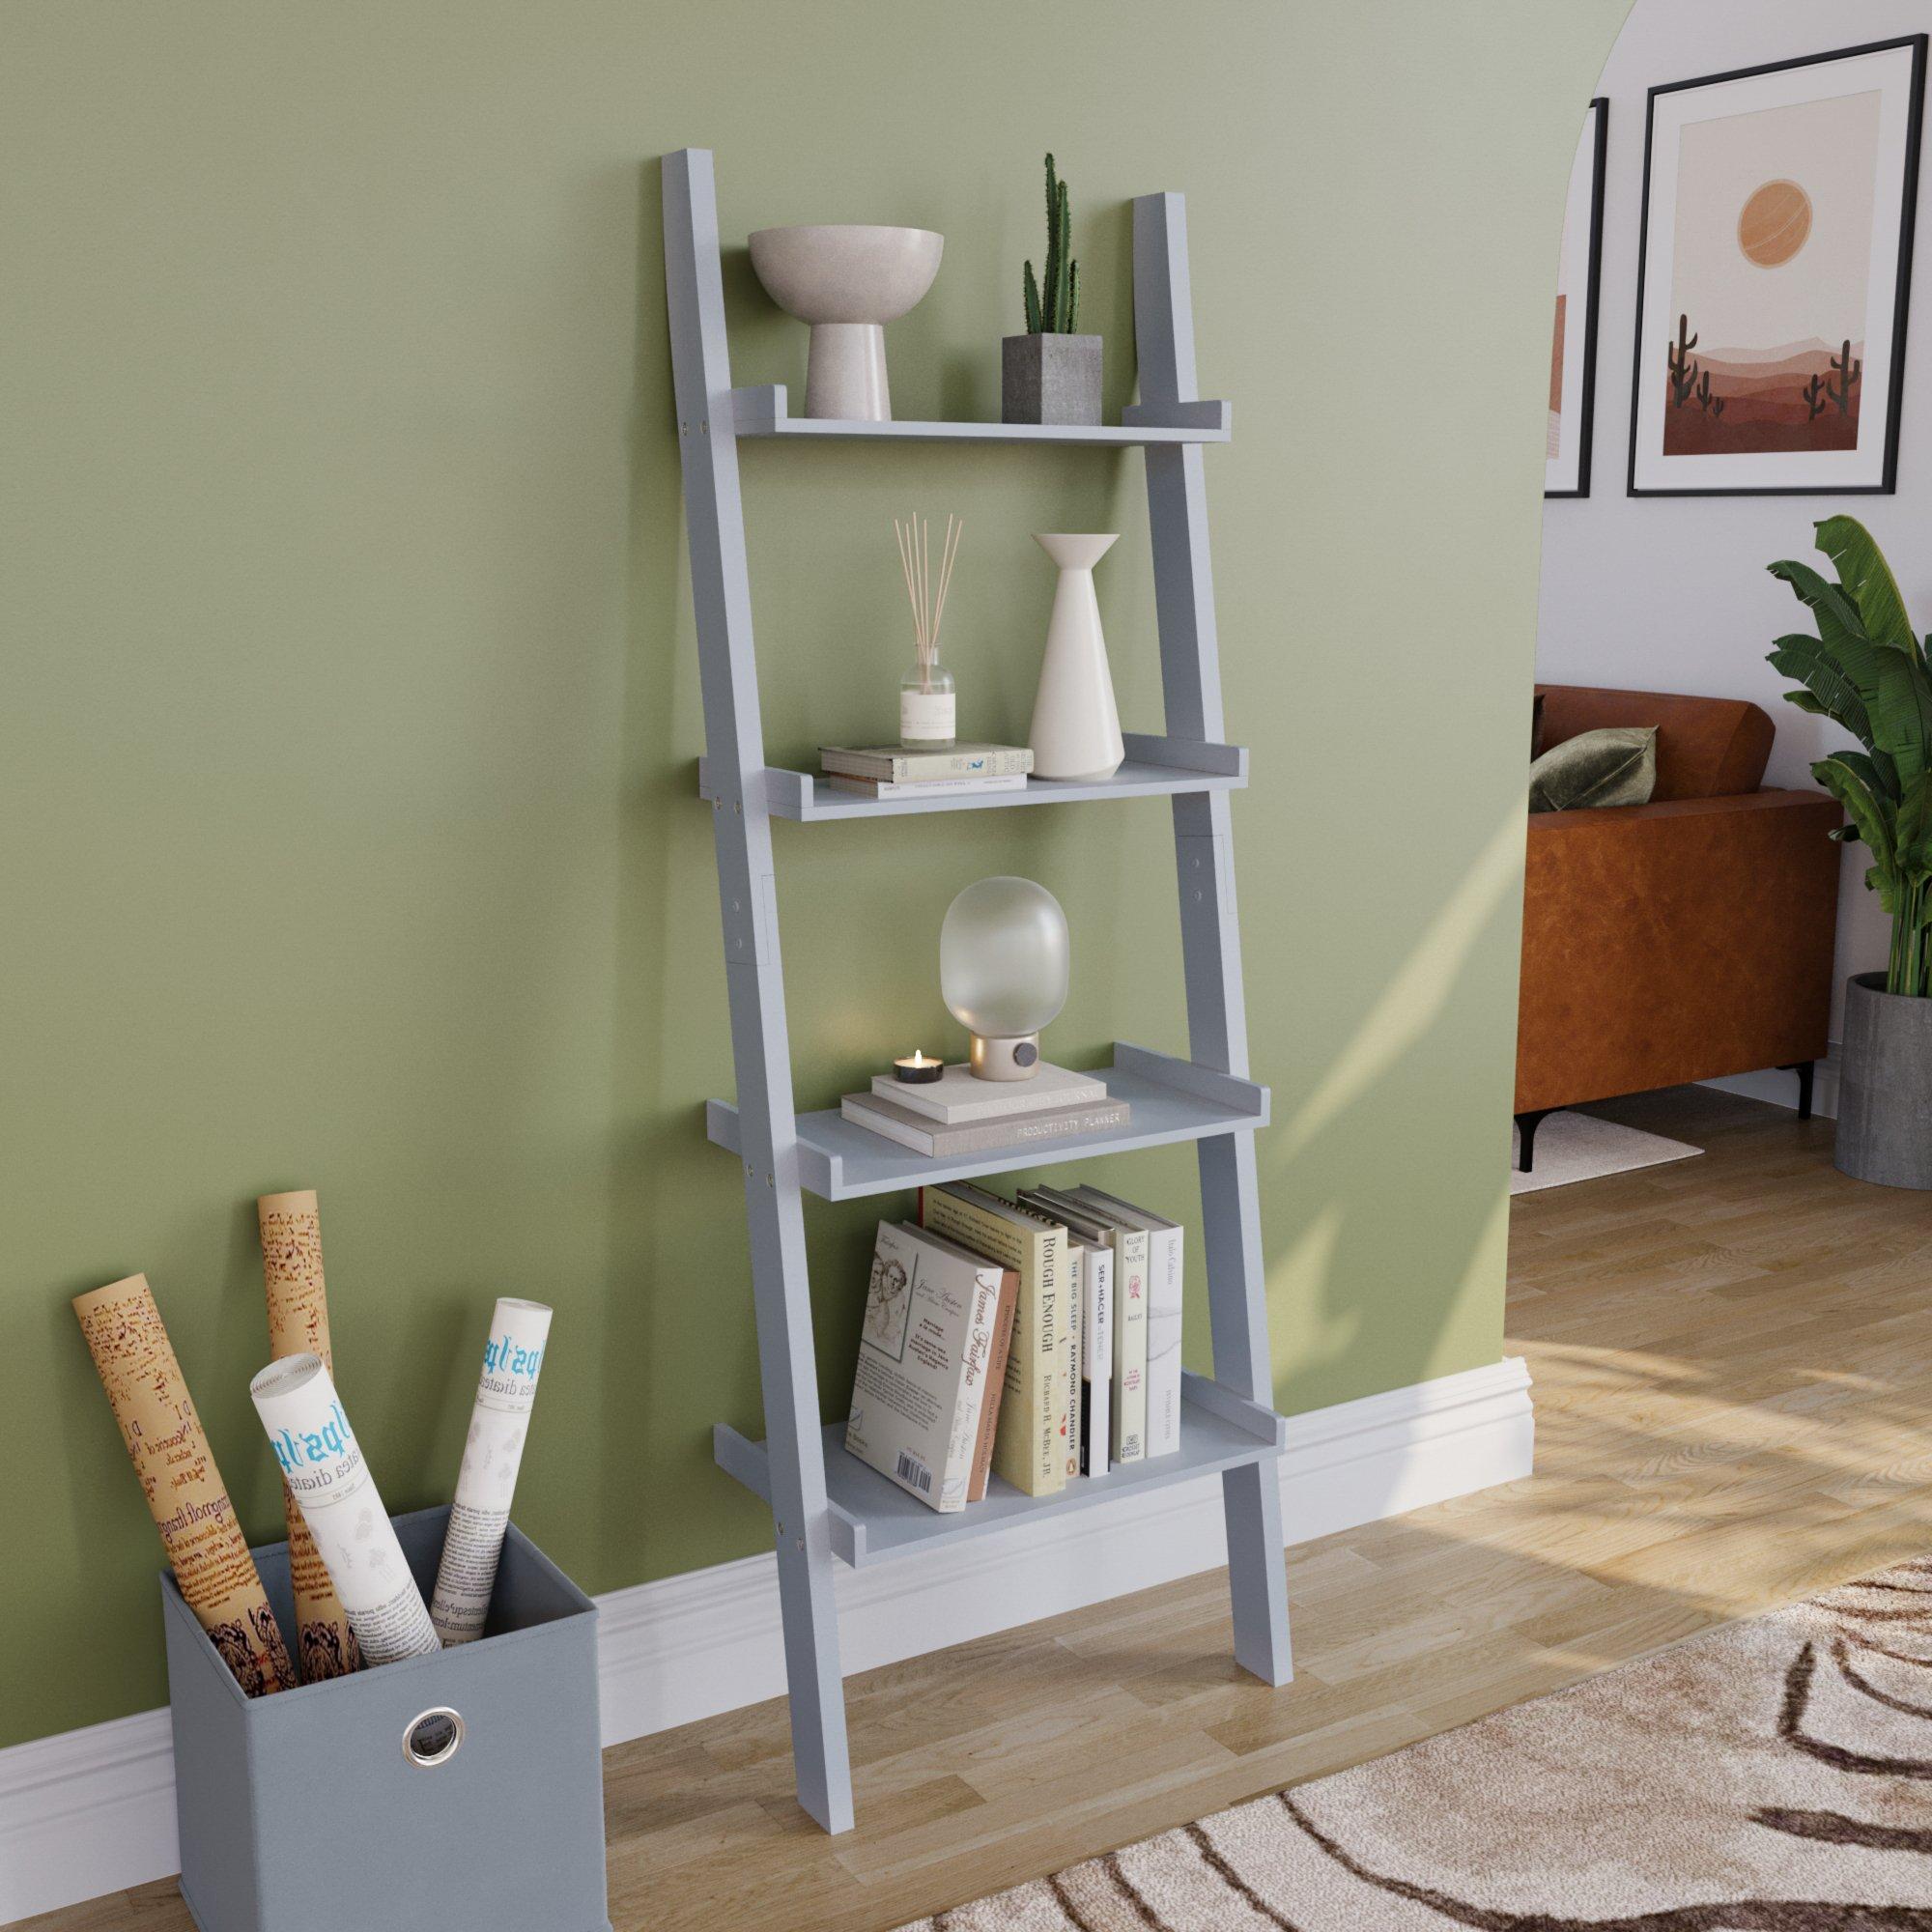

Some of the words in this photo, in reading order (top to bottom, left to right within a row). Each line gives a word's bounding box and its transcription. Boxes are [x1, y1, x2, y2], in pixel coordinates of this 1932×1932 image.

[1017, 1121, 1078, 1138] PRODUCTIVITY
[1085, 1112, 1121, 1127] PLANNER
[1042, 1236, 1056, 1288] ROUGH
[1132, 1245, 1140, 1254] OF
[975, 1274, 996, 1325] James
[1041, 1293, 1056, 1353] ENOUGH
[961, 1327, 989, 1386] Fairfax
